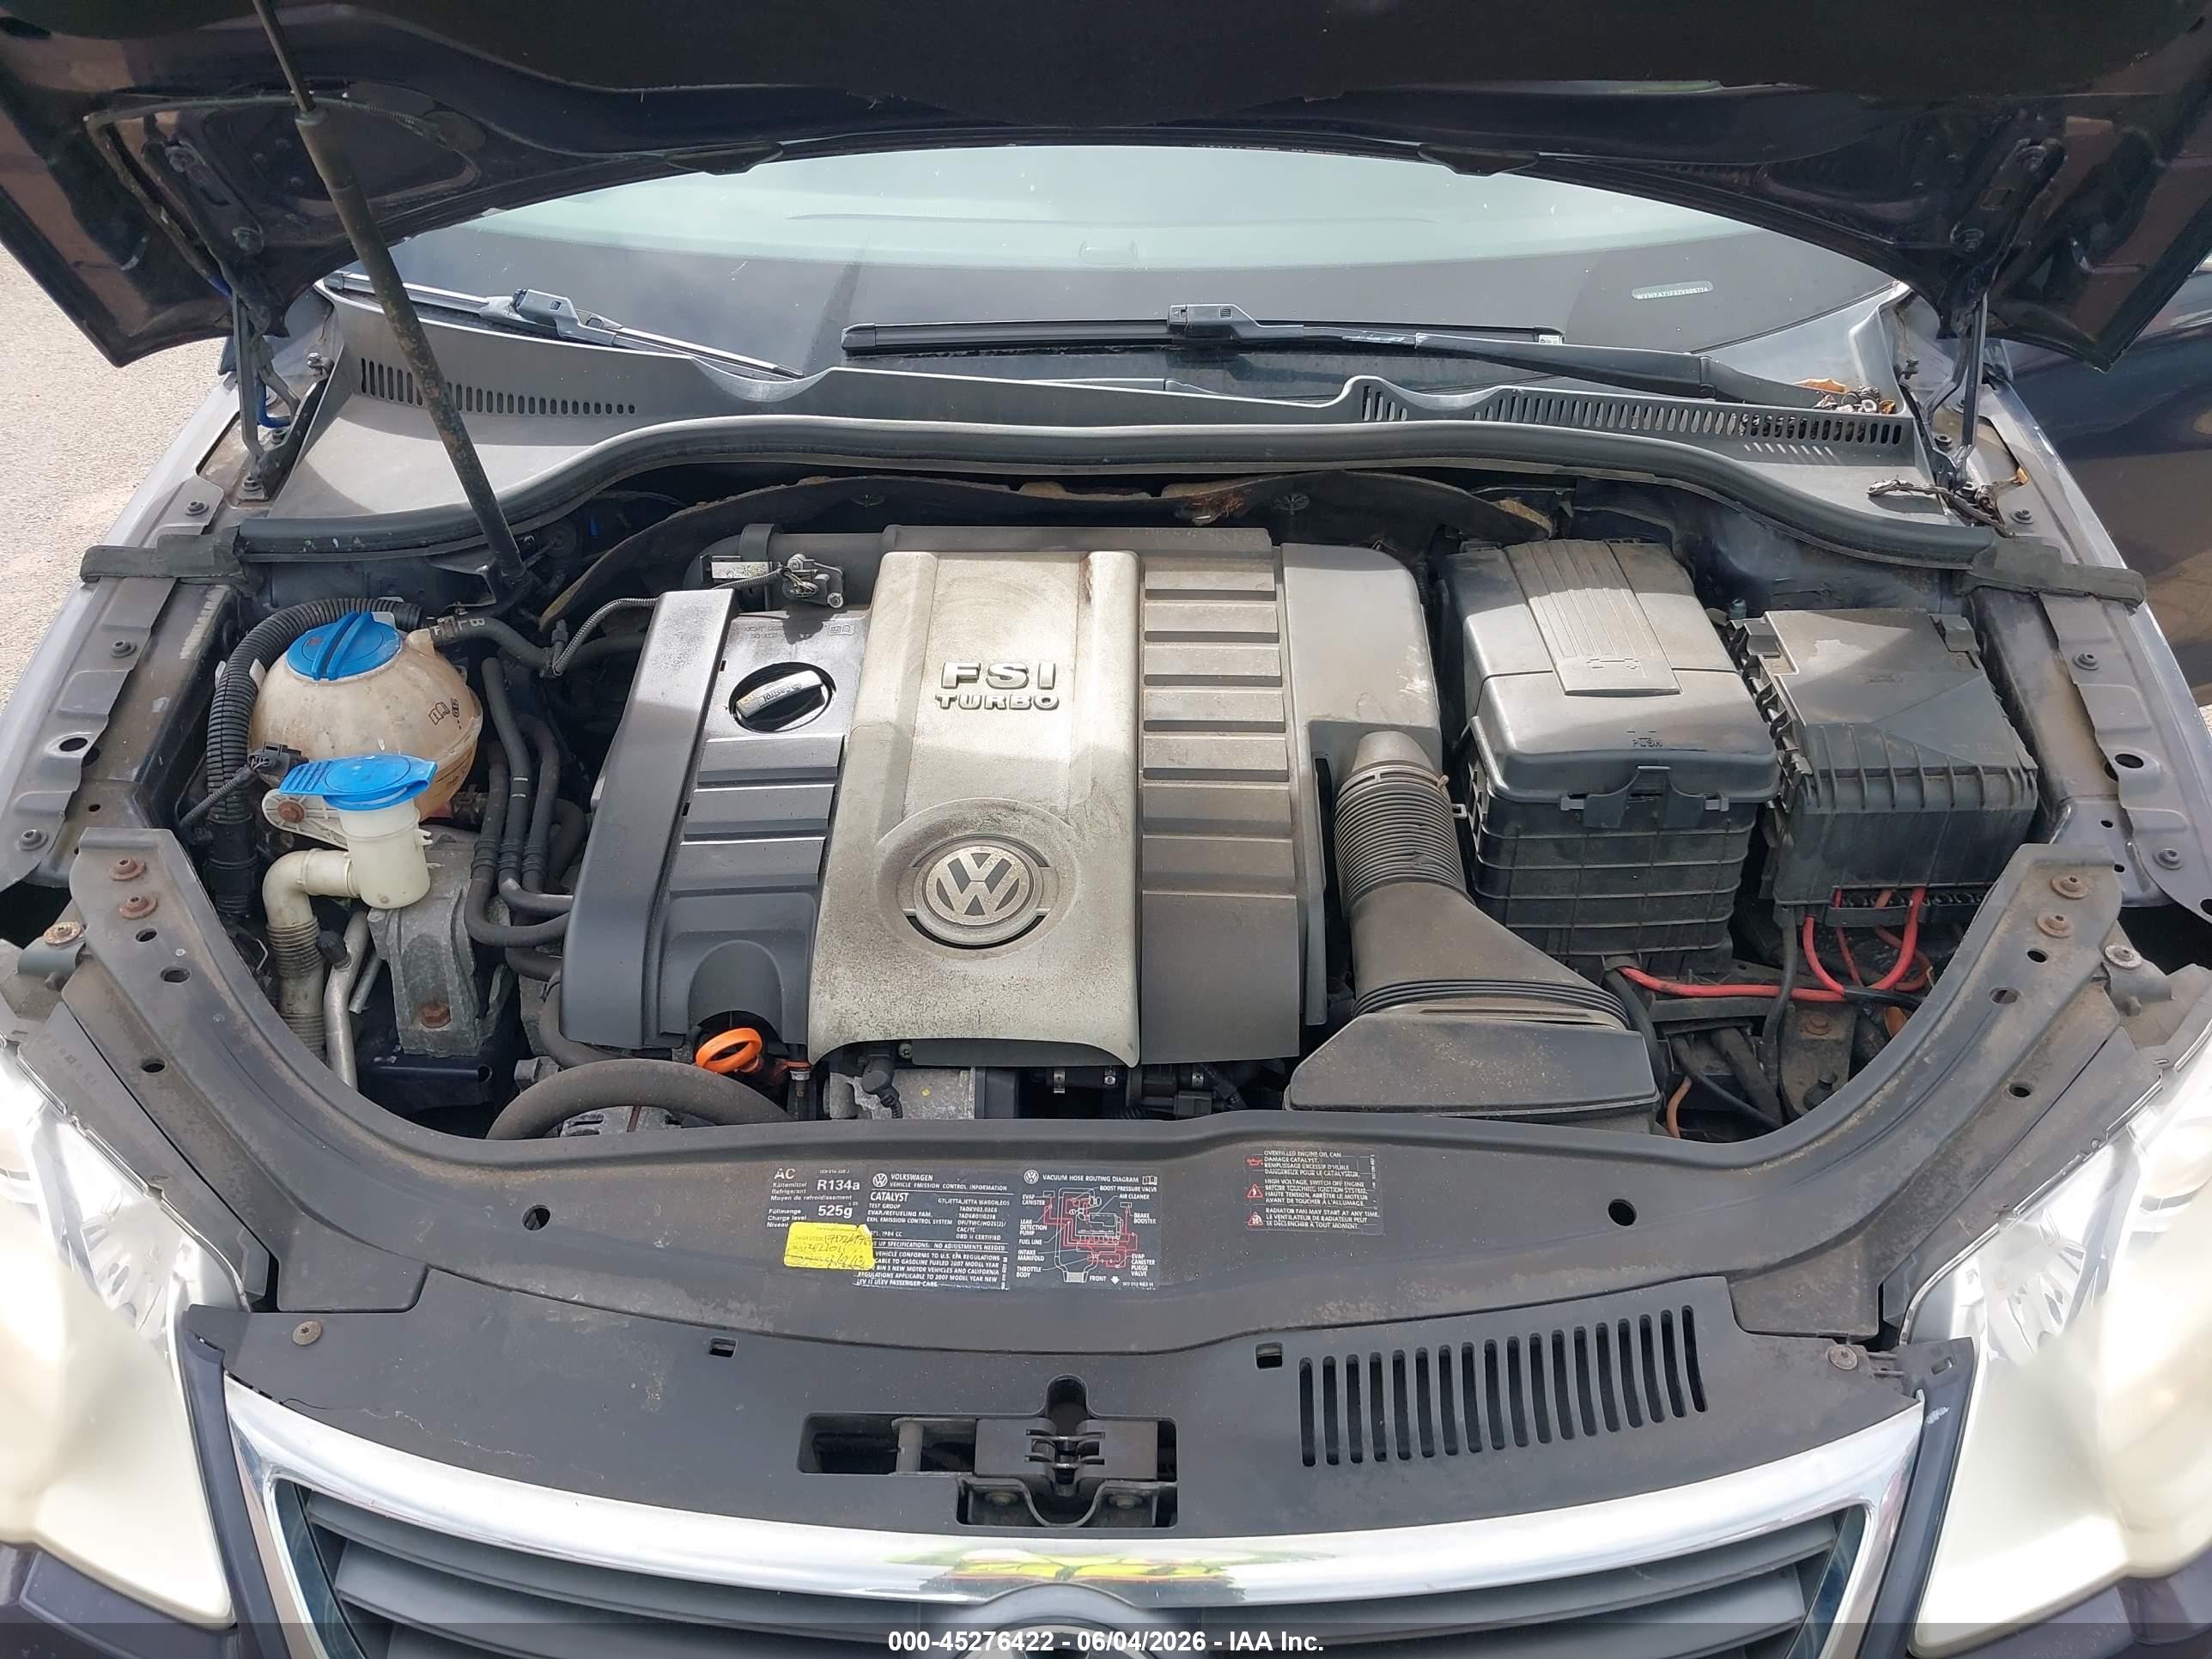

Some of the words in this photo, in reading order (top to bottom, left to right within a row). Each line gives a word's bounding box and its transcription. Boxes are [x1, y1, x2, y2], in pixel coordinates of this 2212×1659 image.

[941, 660, 1056, 690] FSI
[935, 694, 1060, 711] TURBO
[774, 1168, 795, 1180] AC
[890, 1173, 933, 1182] VOLKSWAGEN
[817, 1179, 860, 1191] R134a
[870, 1192, 909, 1202] CATALYST
[817, 1205, 853, 1218] 525g
